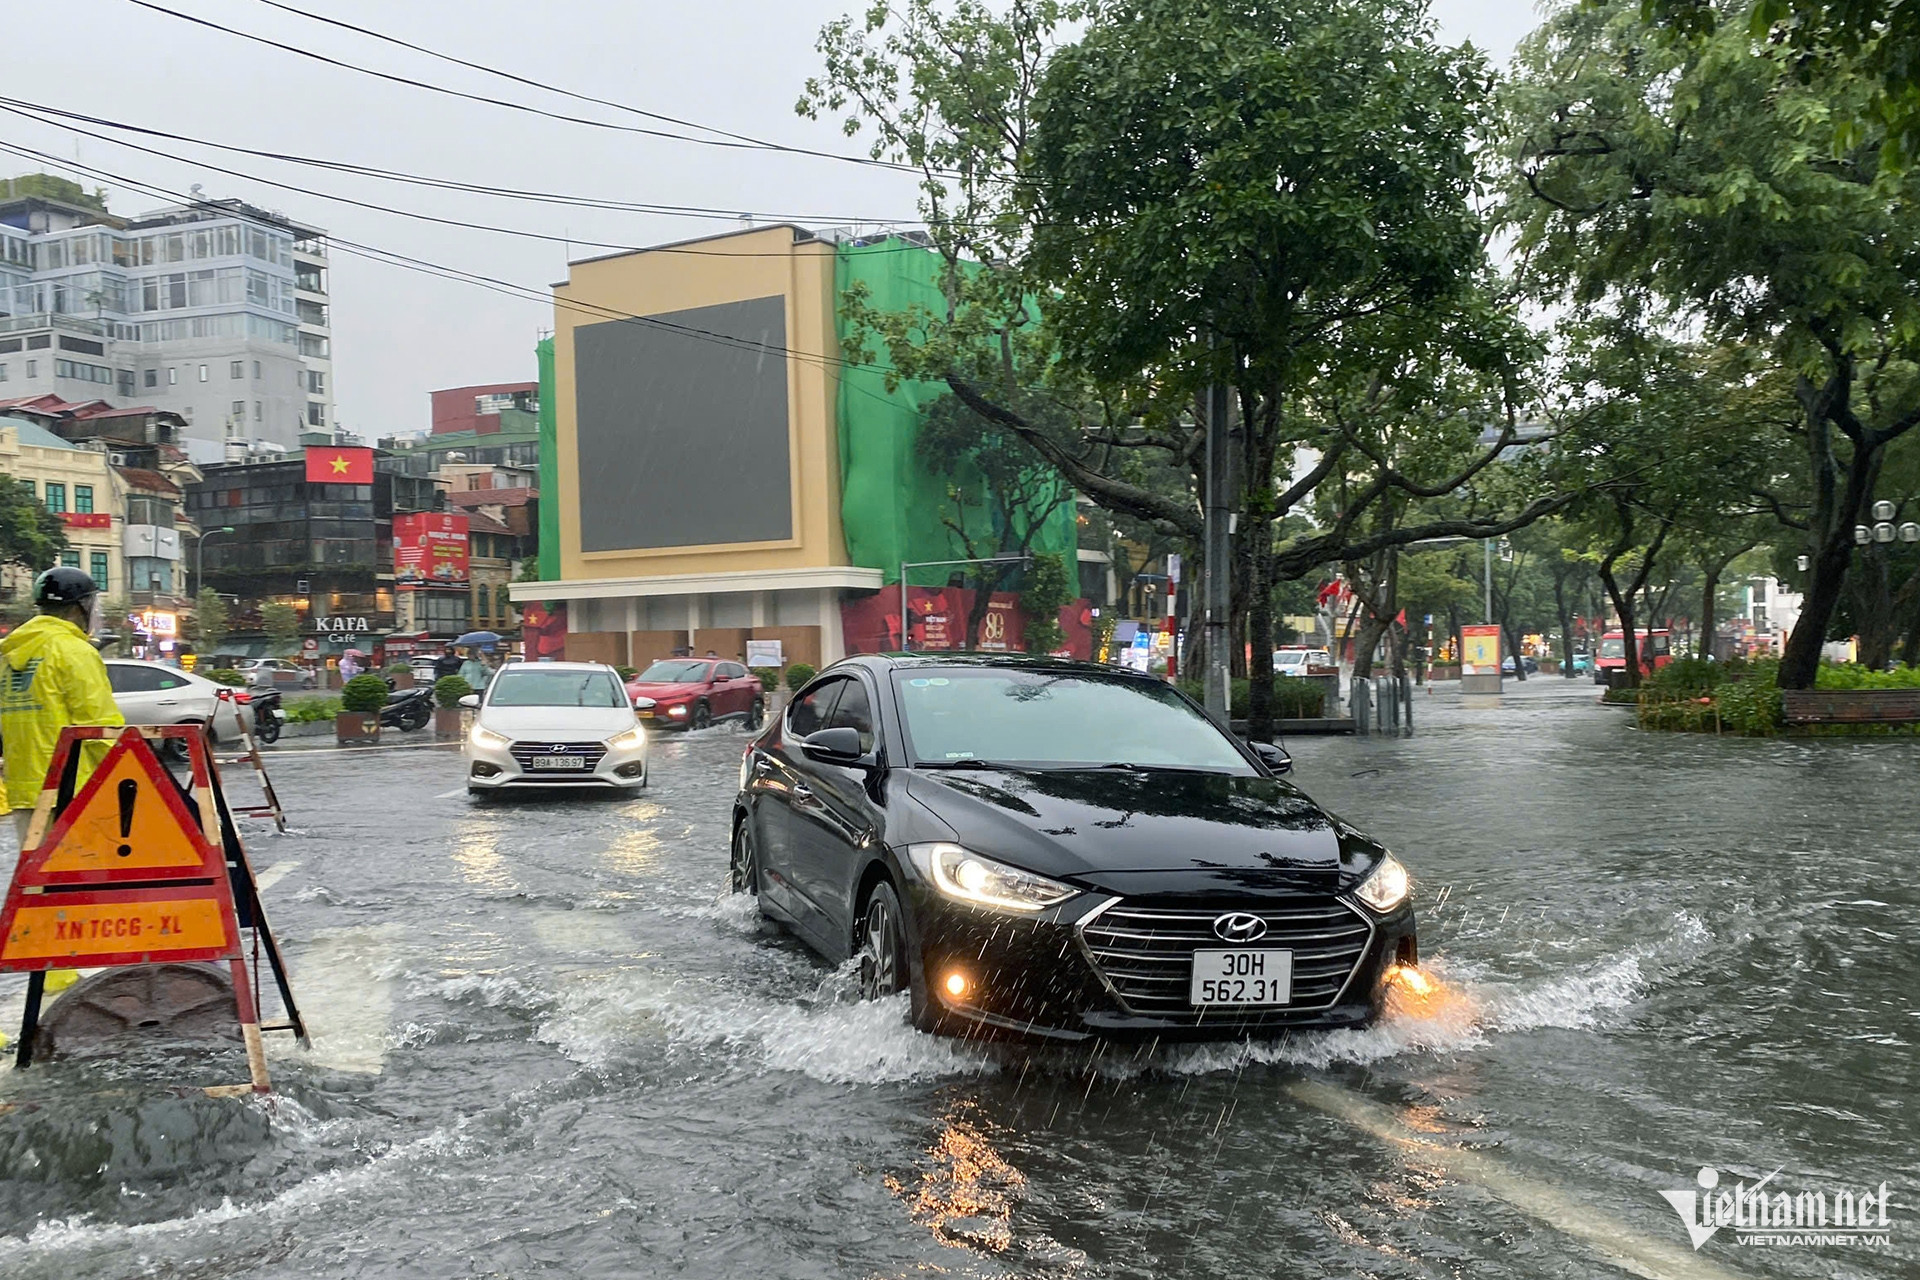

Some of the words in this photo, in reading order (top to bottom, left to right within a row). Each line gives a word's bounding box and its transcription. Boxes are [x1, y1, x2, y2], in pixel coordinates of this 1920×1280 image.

[315, 617, 369, 631] KAFA
[328, 633, 356, 643] Café
[1222, 953, 1265, 976] 30H
[1202, 979, 1278, 1002] 562.31
